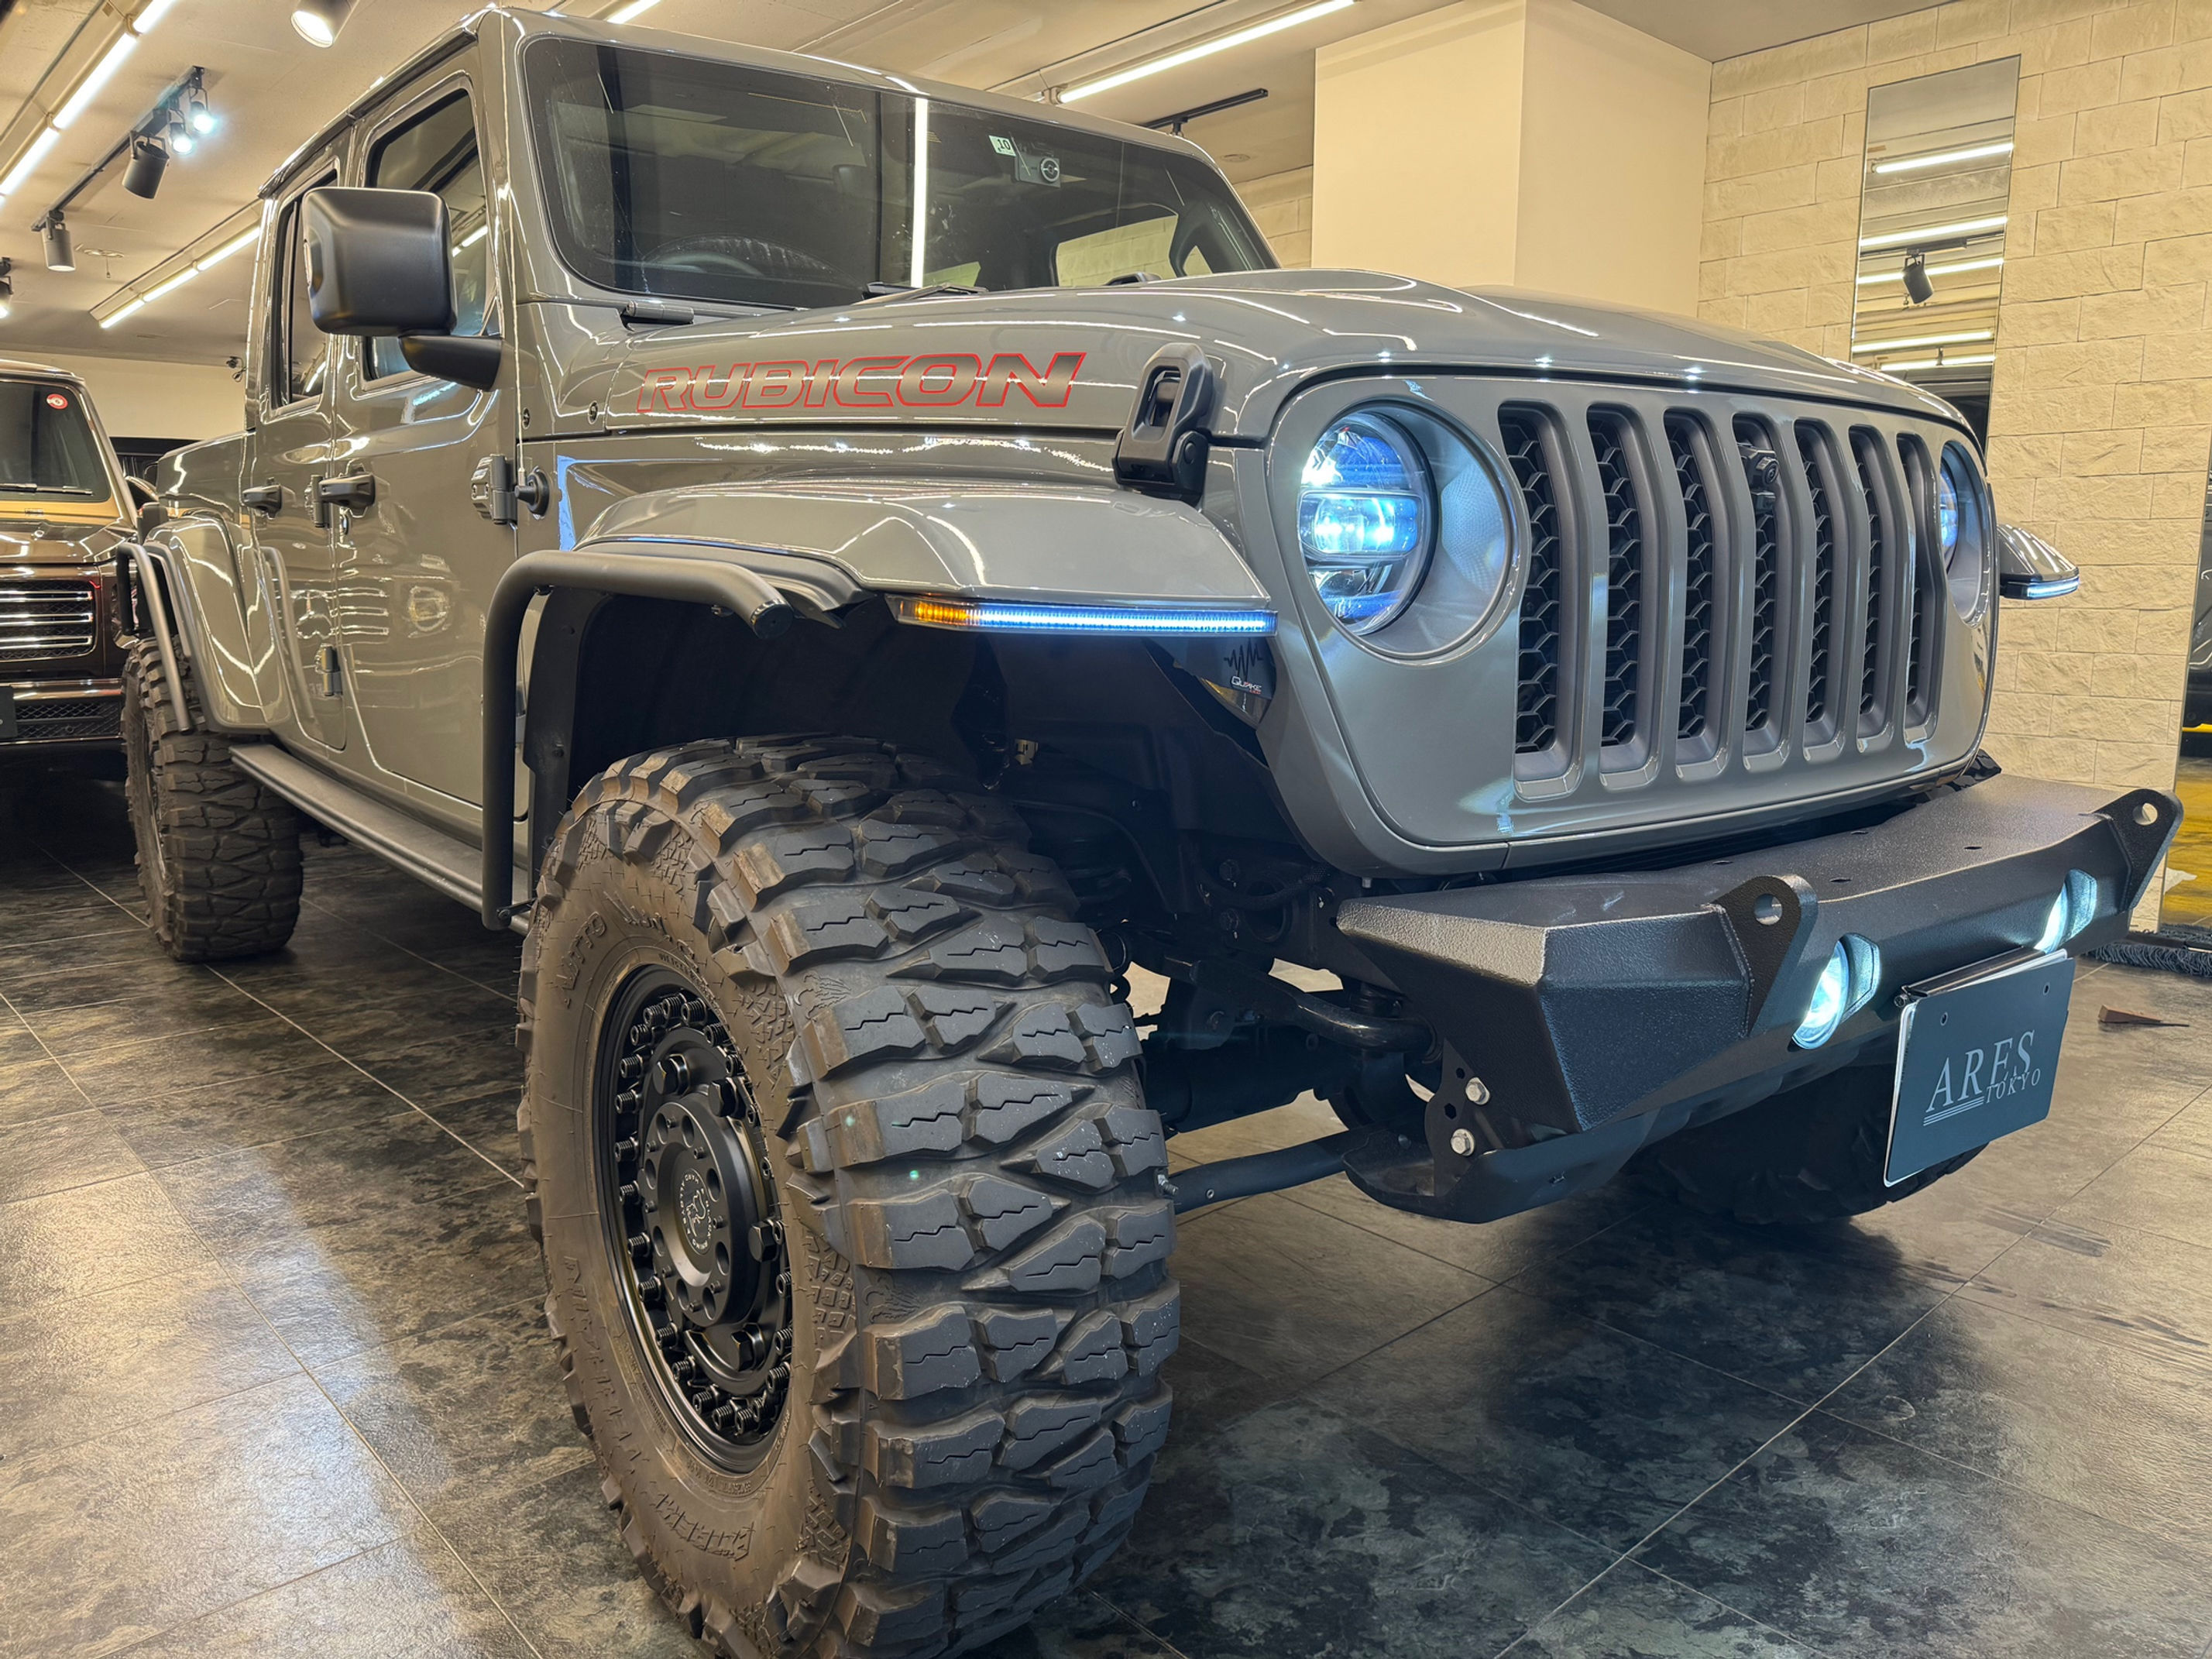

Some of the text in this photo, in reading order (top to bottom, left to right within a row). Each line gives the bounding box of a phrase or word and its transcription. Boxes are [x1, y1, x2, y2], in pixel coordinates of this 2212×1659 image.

[997, 139, 1011, 150] 10
[637, 352, 1087, 412] RUBICON
[1925, 1029, 2035, 1113] ARES
[1986, 1067, 2042, 1104] TOKYO
